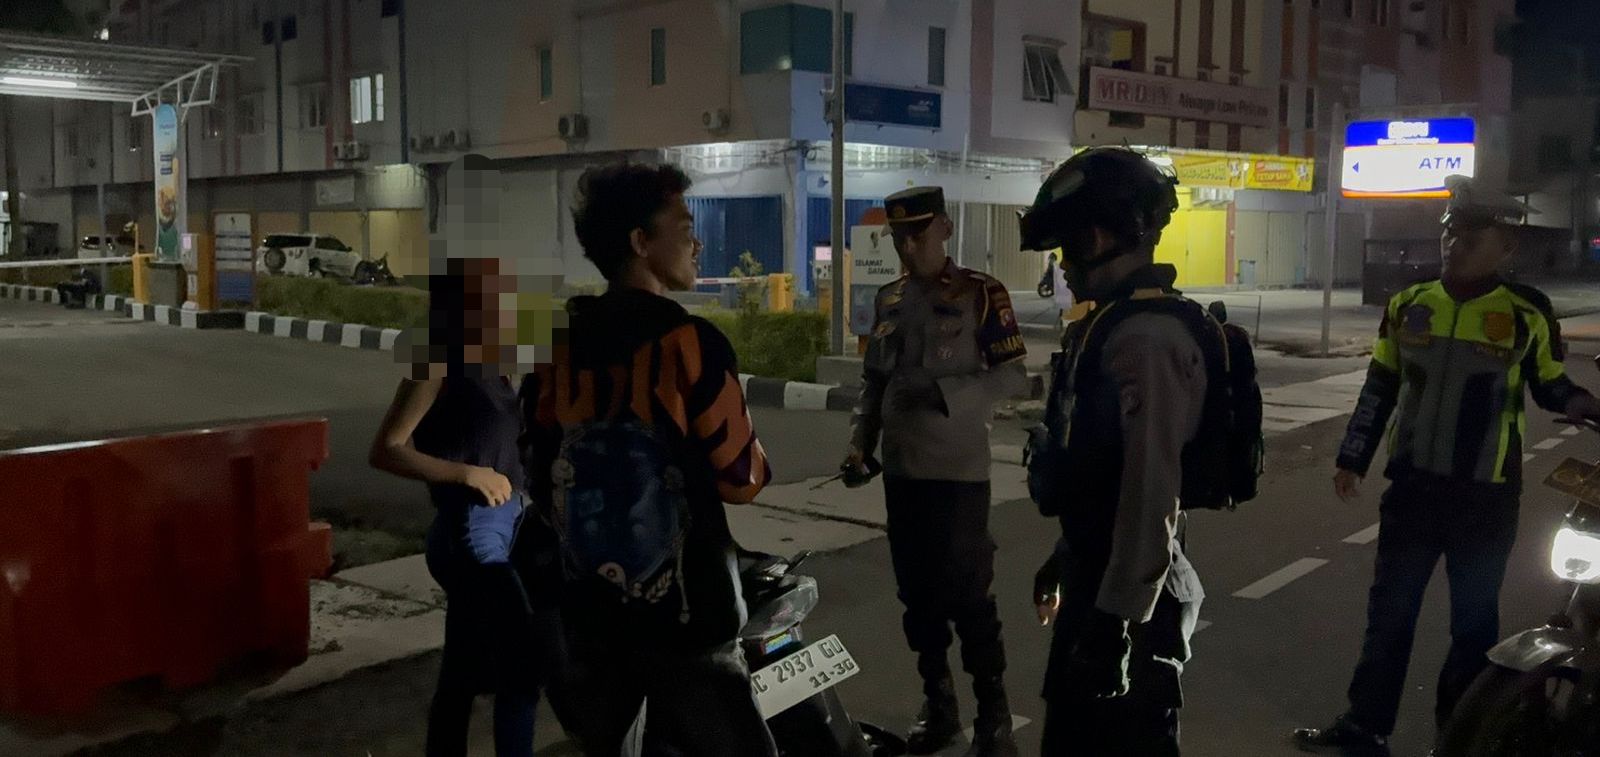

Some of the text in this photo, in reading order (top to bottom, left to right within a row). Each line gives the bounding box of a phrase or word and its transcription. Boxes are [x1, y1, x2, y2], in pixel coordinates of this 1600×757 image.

[1419, 157, 1461, 169] ATM
[855, 259, 883, 267] SELAMAT
[867, 267, 896, 275] DATANG
[773, 650, 815, 683] 2937
[819, 637, 844, 659] GU
